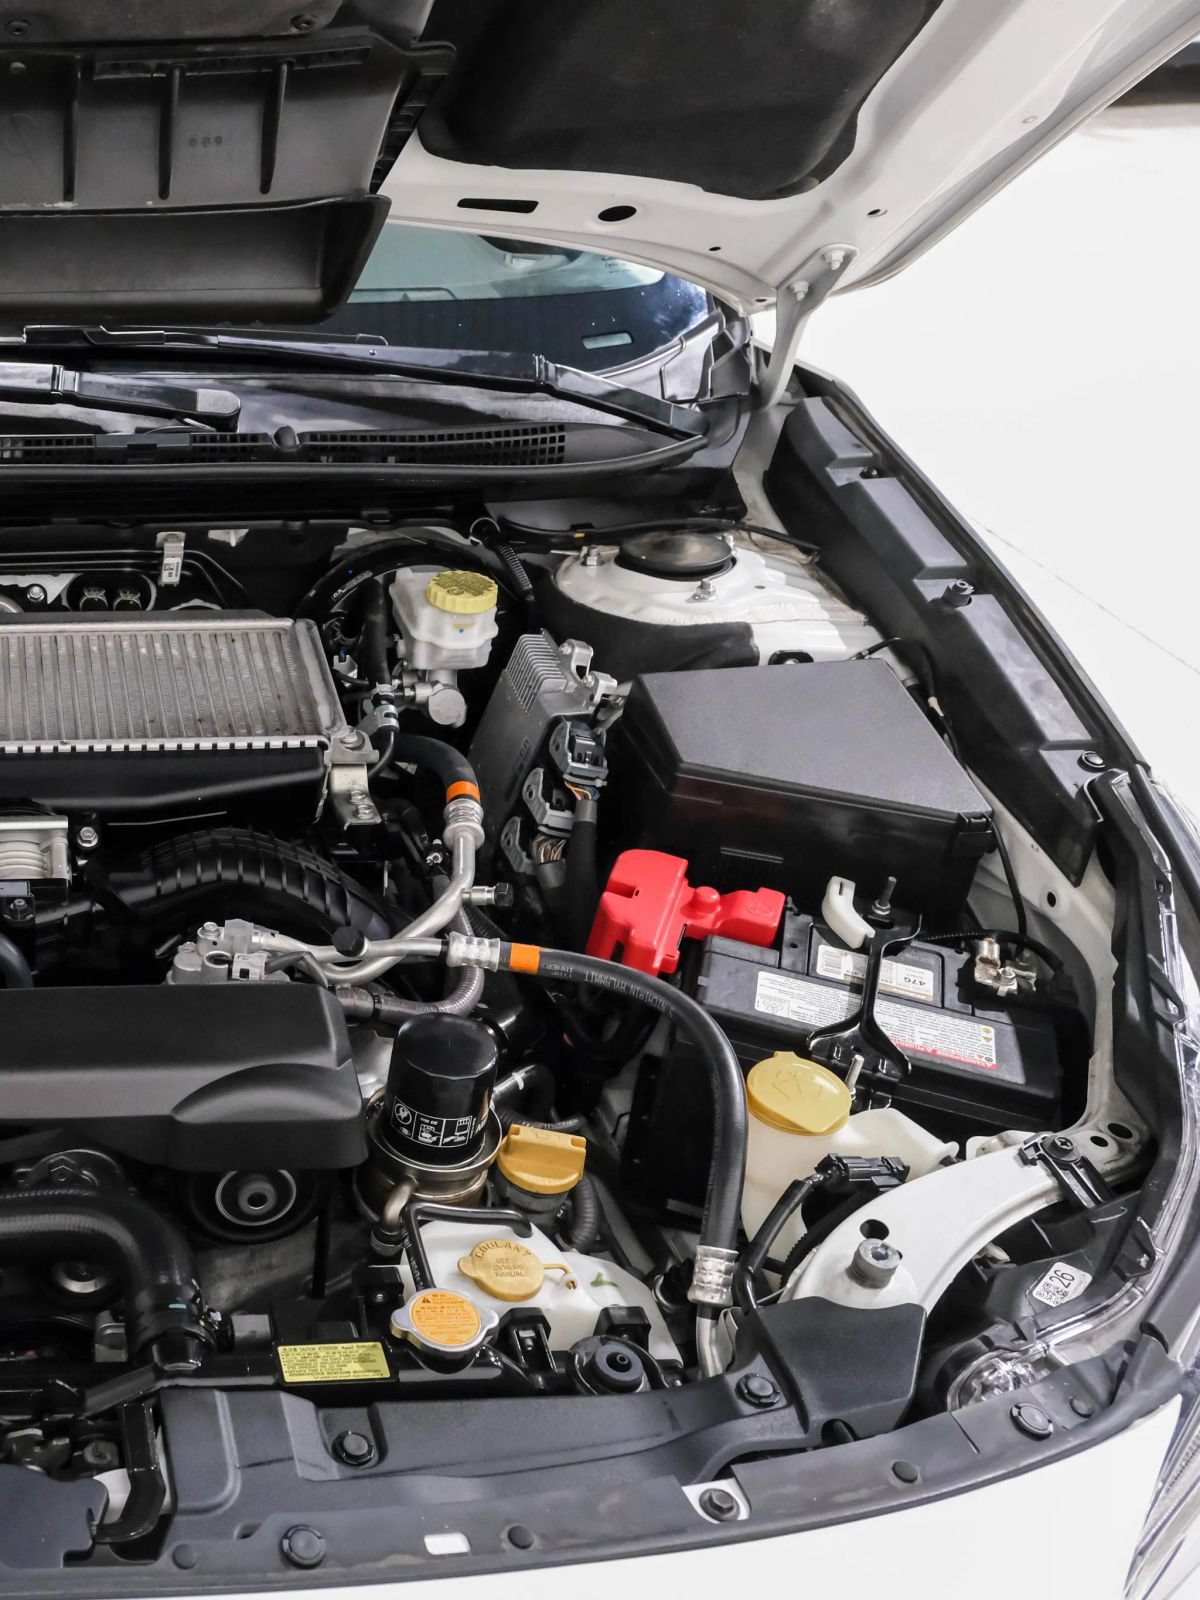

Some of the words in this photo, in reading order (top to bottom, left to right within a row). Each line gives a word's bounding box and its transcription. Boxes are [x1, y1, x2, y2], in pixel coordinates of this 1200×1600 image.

[903, 976, 926, 986] 47G
[475, 1241, 532, 1258] COOLANT
[1049, 1269, 1075, 1289] 26
